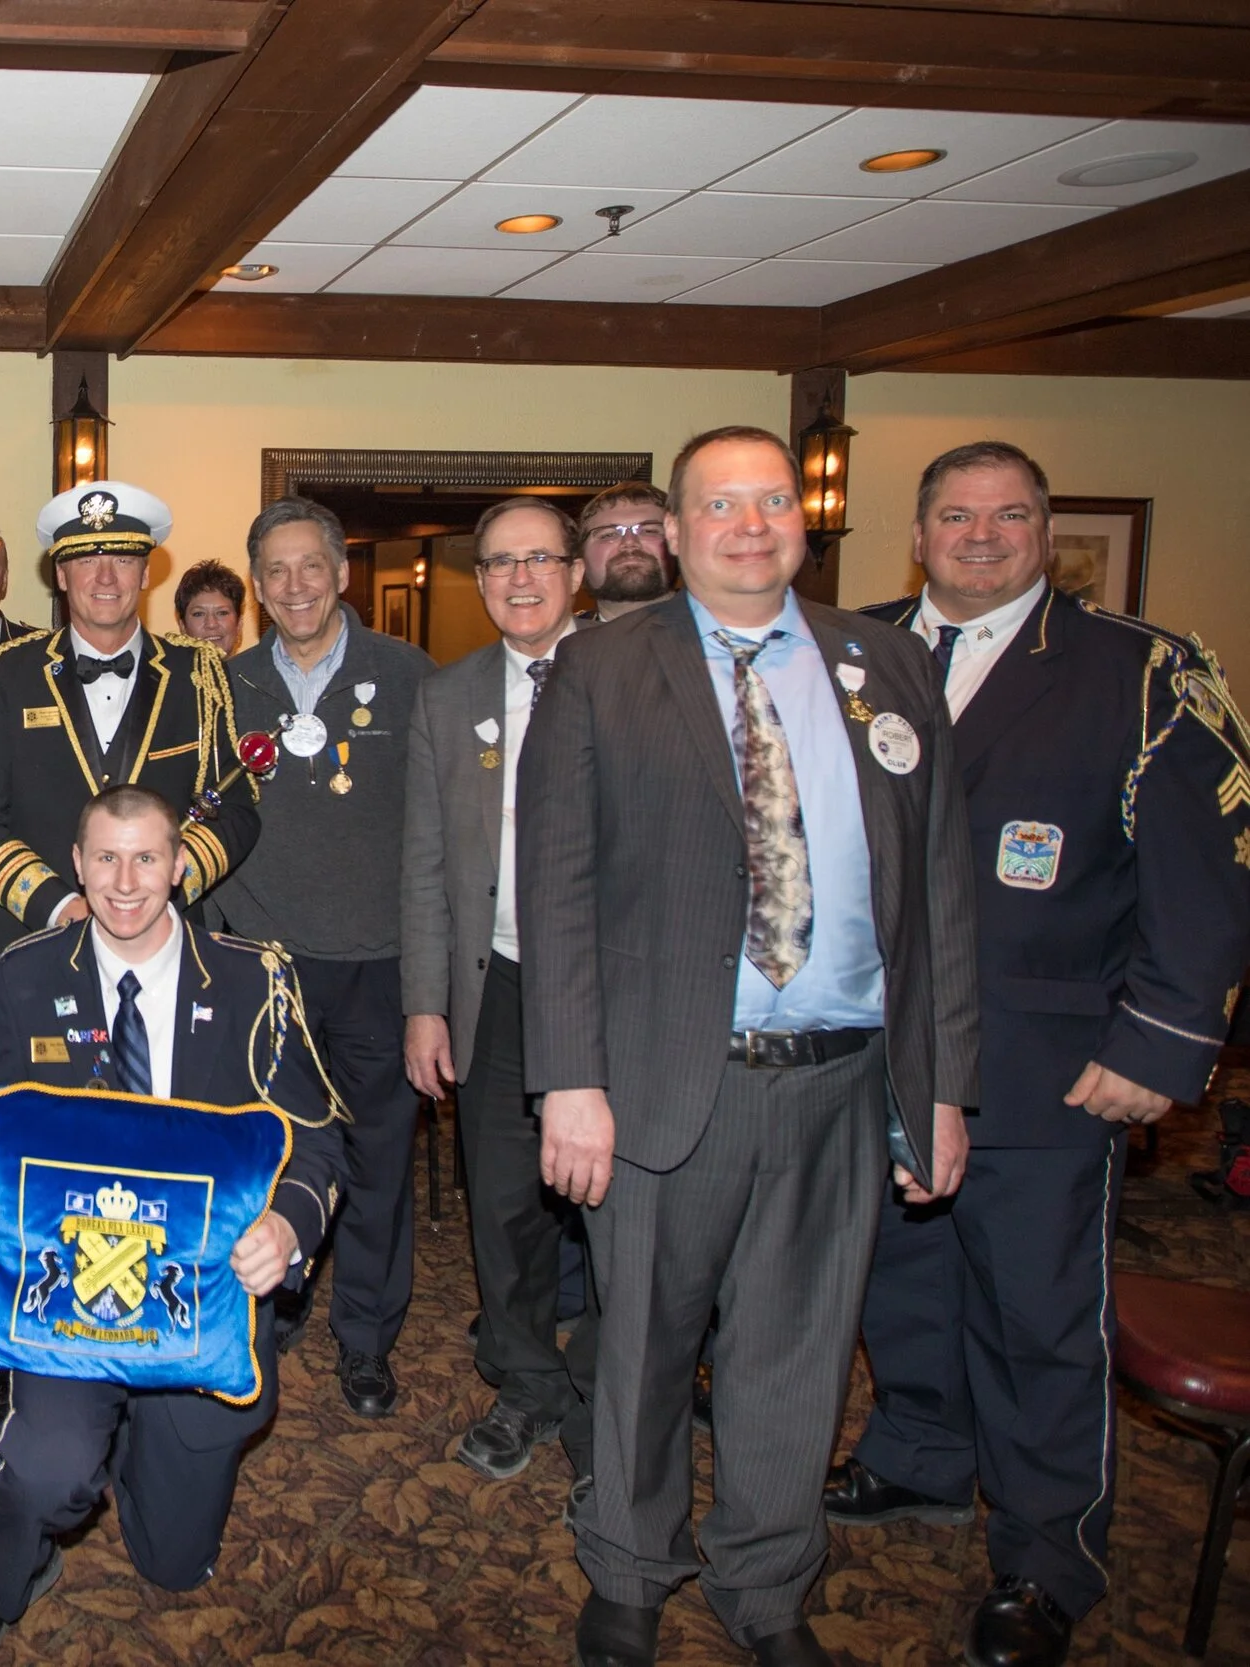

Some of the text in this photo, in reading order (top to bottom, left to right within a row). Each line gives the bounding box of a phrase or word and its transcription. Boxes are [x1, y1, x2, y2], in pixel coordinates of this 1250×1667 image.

[882, 730, 913, 743] ROBERT
[887, 759, 907, 768] CLUB
[82, 1325, 97, 1337] TOM
[99, 1328, 136, 1340] LEONARD
